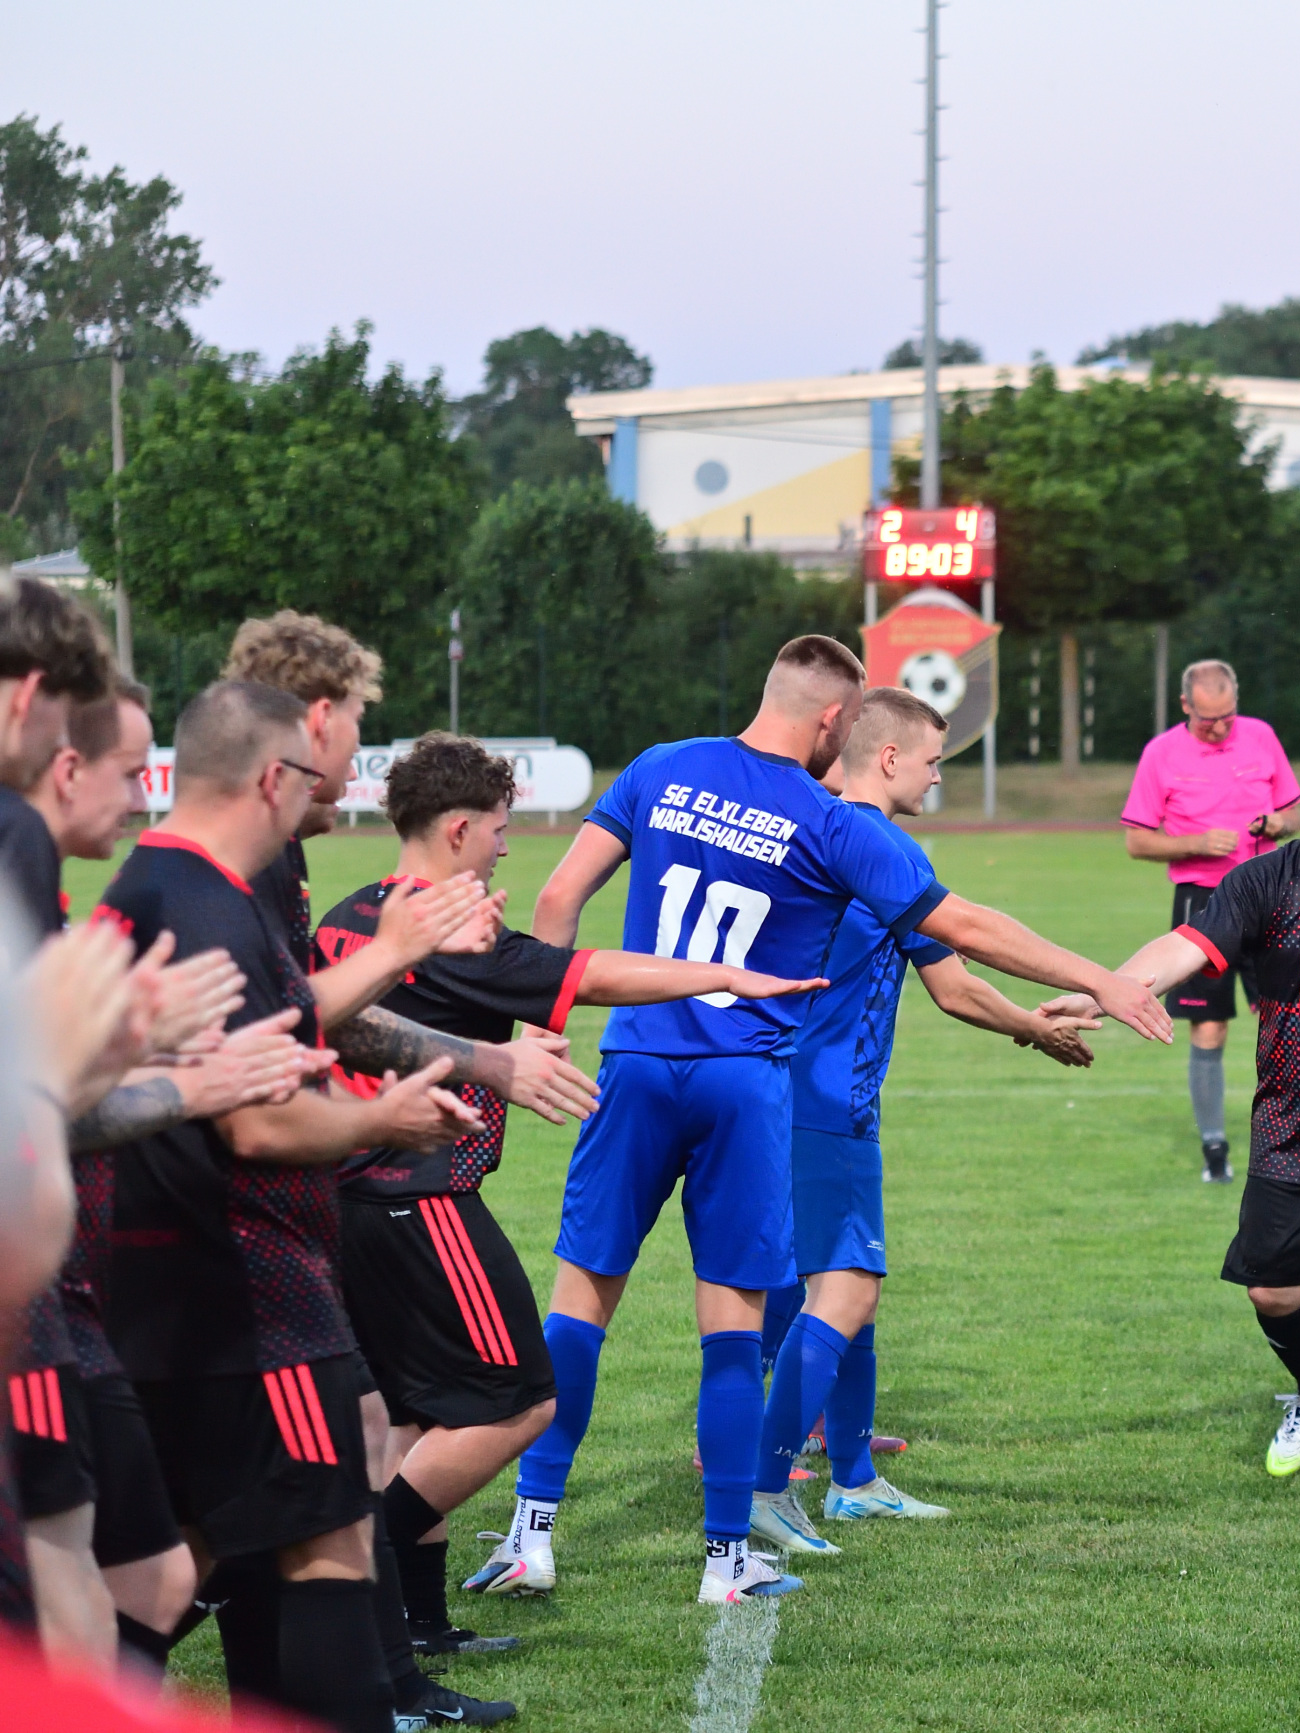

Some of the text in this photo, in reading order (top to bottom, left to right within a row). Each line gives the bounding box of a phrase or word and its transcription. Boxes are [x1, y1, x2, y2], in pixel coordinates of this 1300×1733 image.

[880, 510, 902, 542] 2
[955, 509, 978, 542] 4
[649, 806, 790, 867] MARLISHAUSEN
[660, 783, 798, 842] SG ELXLEBEN
[655, 863, 771, 1008] 10
